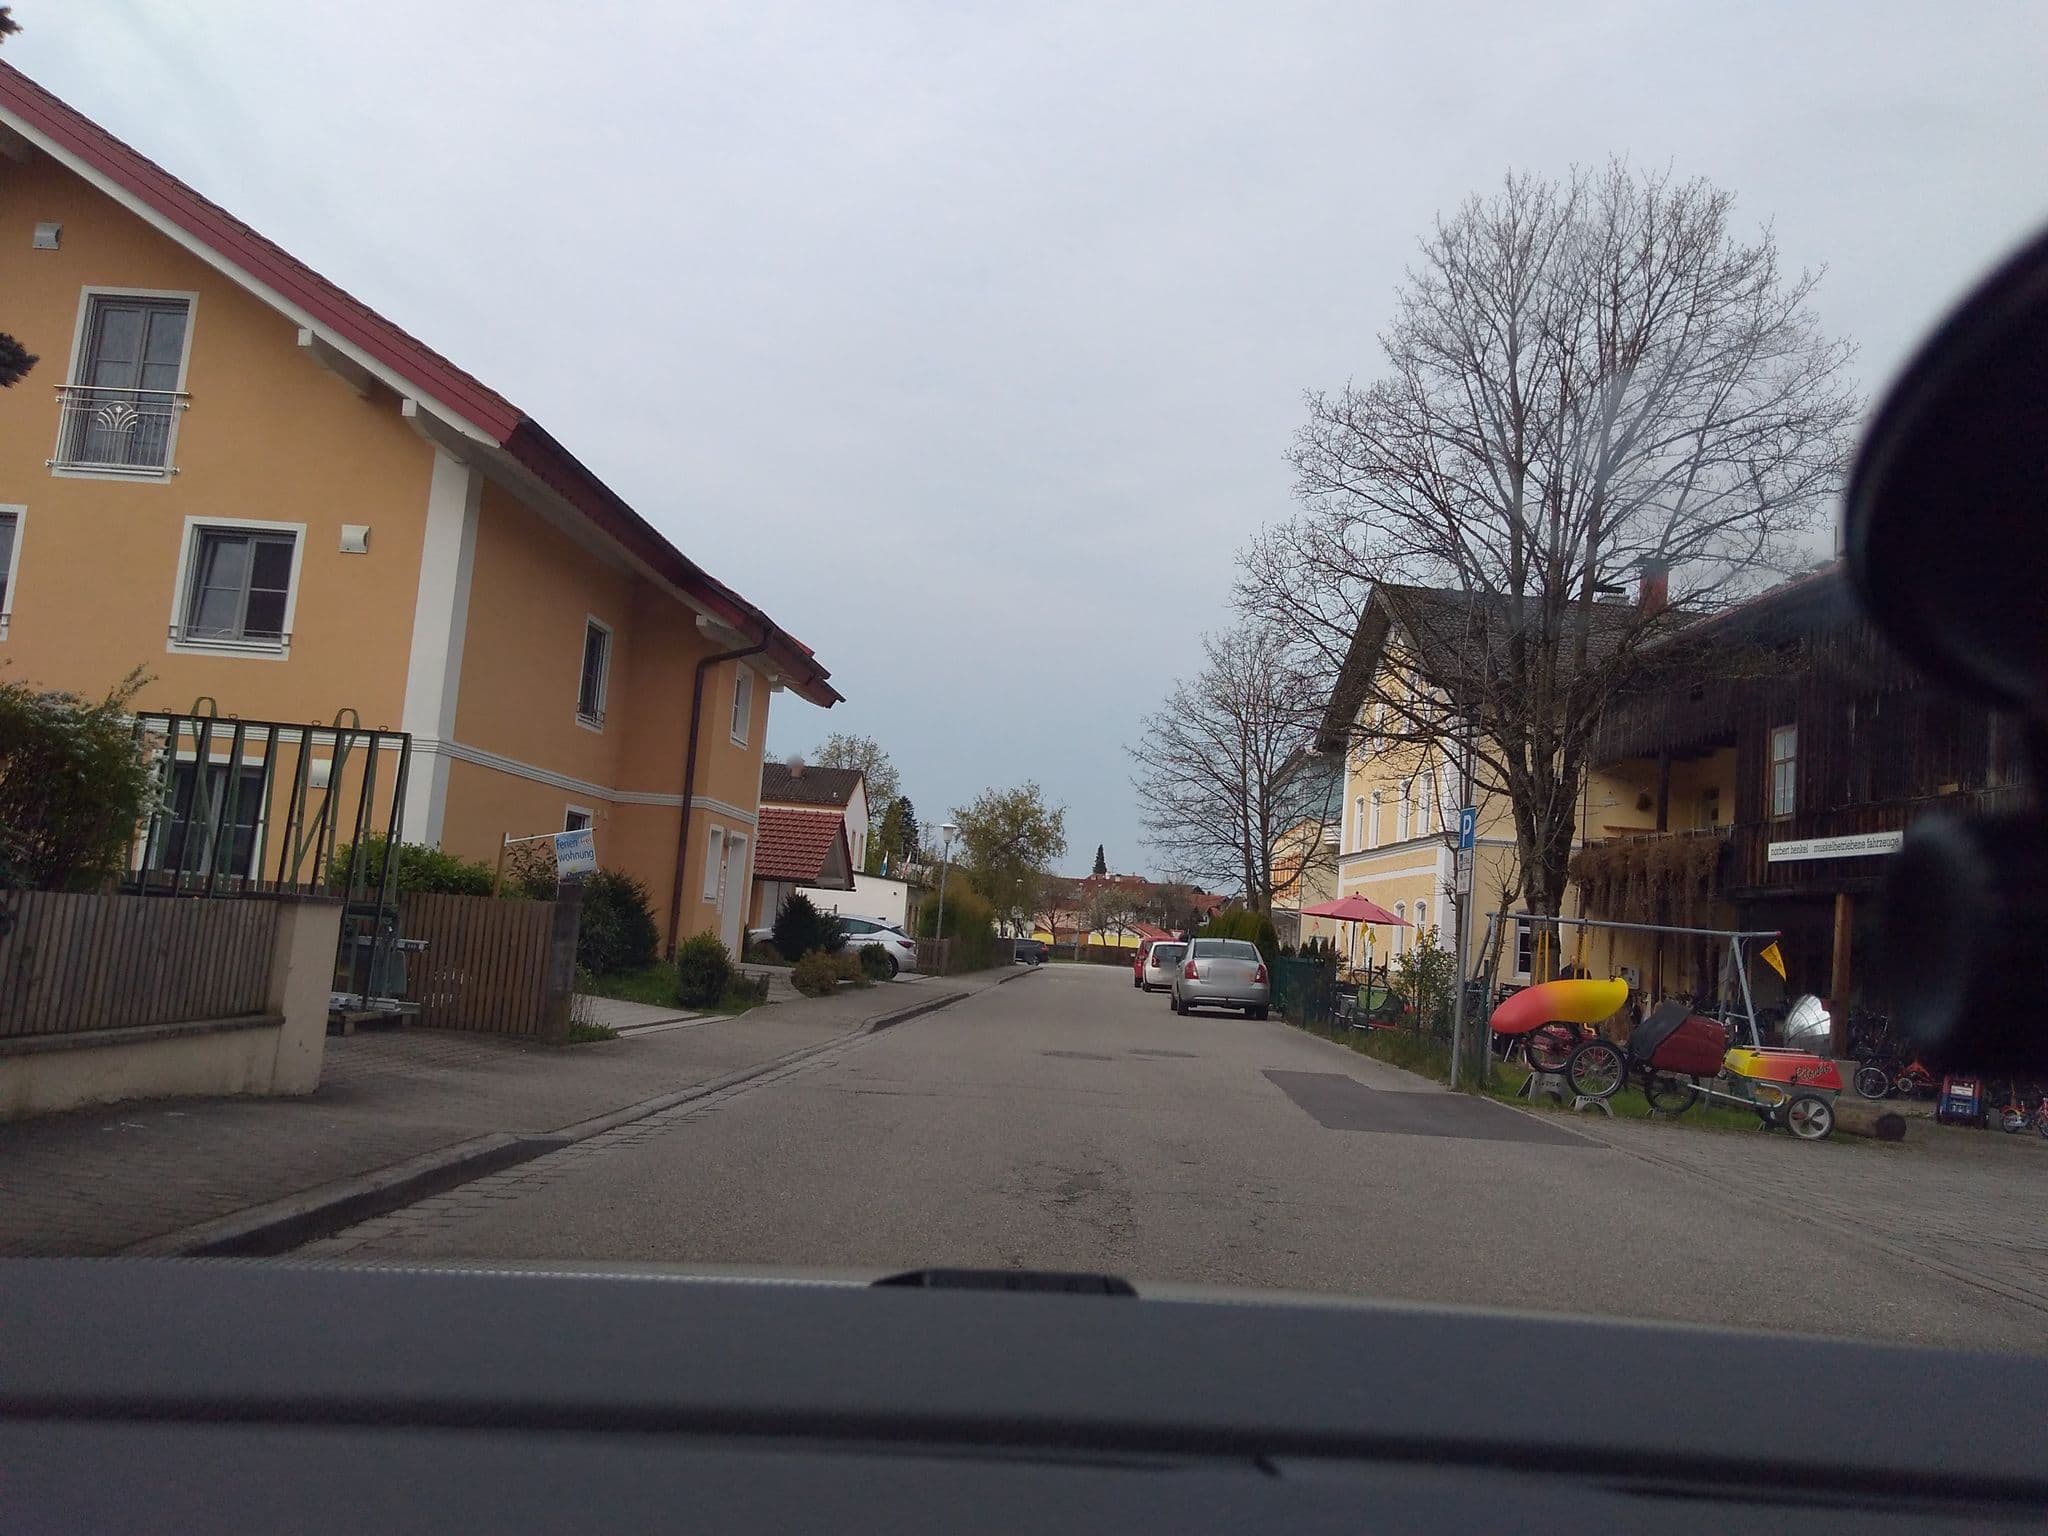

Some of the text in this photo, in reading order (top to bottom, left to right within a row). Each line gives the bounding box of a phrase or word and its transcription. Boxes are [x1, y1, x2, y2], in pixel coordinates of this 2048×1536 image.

[1462, 815, 1471, 847] P
[556, 838, 578, 849] Ferien
[1866, 837, 1899, 849] fahrzeuge
